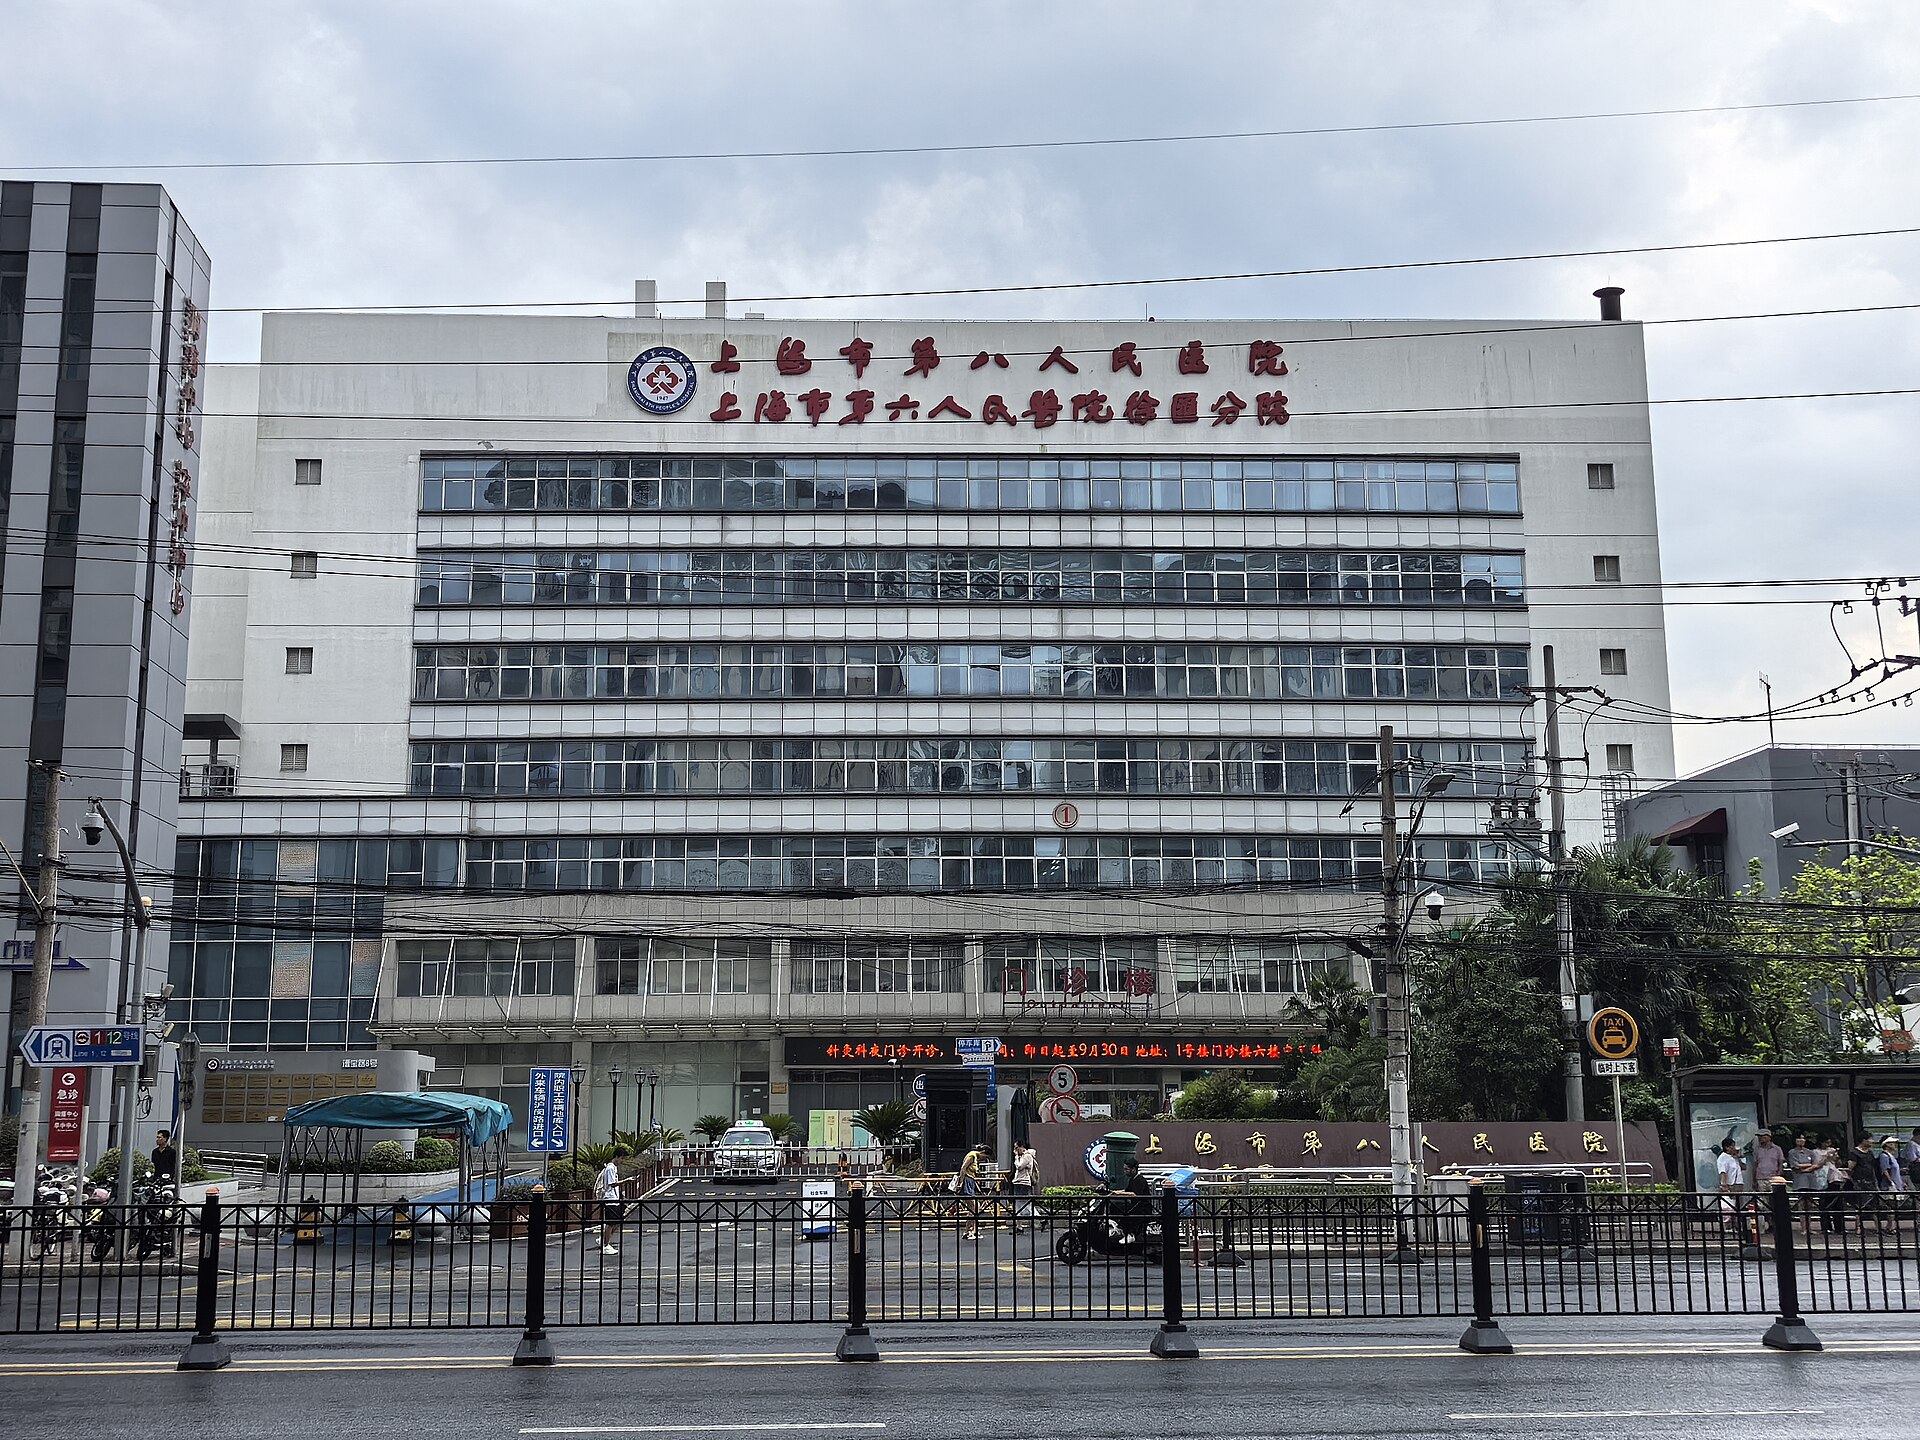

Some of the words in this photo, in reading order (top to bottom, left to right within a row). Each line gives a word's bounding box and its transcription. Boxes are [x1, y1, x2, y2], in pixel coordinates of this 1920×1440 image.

[711, 337, 1288, 378] 上海市第八人民医院
[1061, 806, 1071, 823] 1
[1002, 967, 1153, 997] 门诊楼
[1602, 1018, 1624, 1027] TAXI
[94, 1030, 101, 1044] 1
[107, 1031, 122, 1044] 12
[1058, 1072, 1068, 1088] 5
[57, 1089, 79, 1100] 急诊
